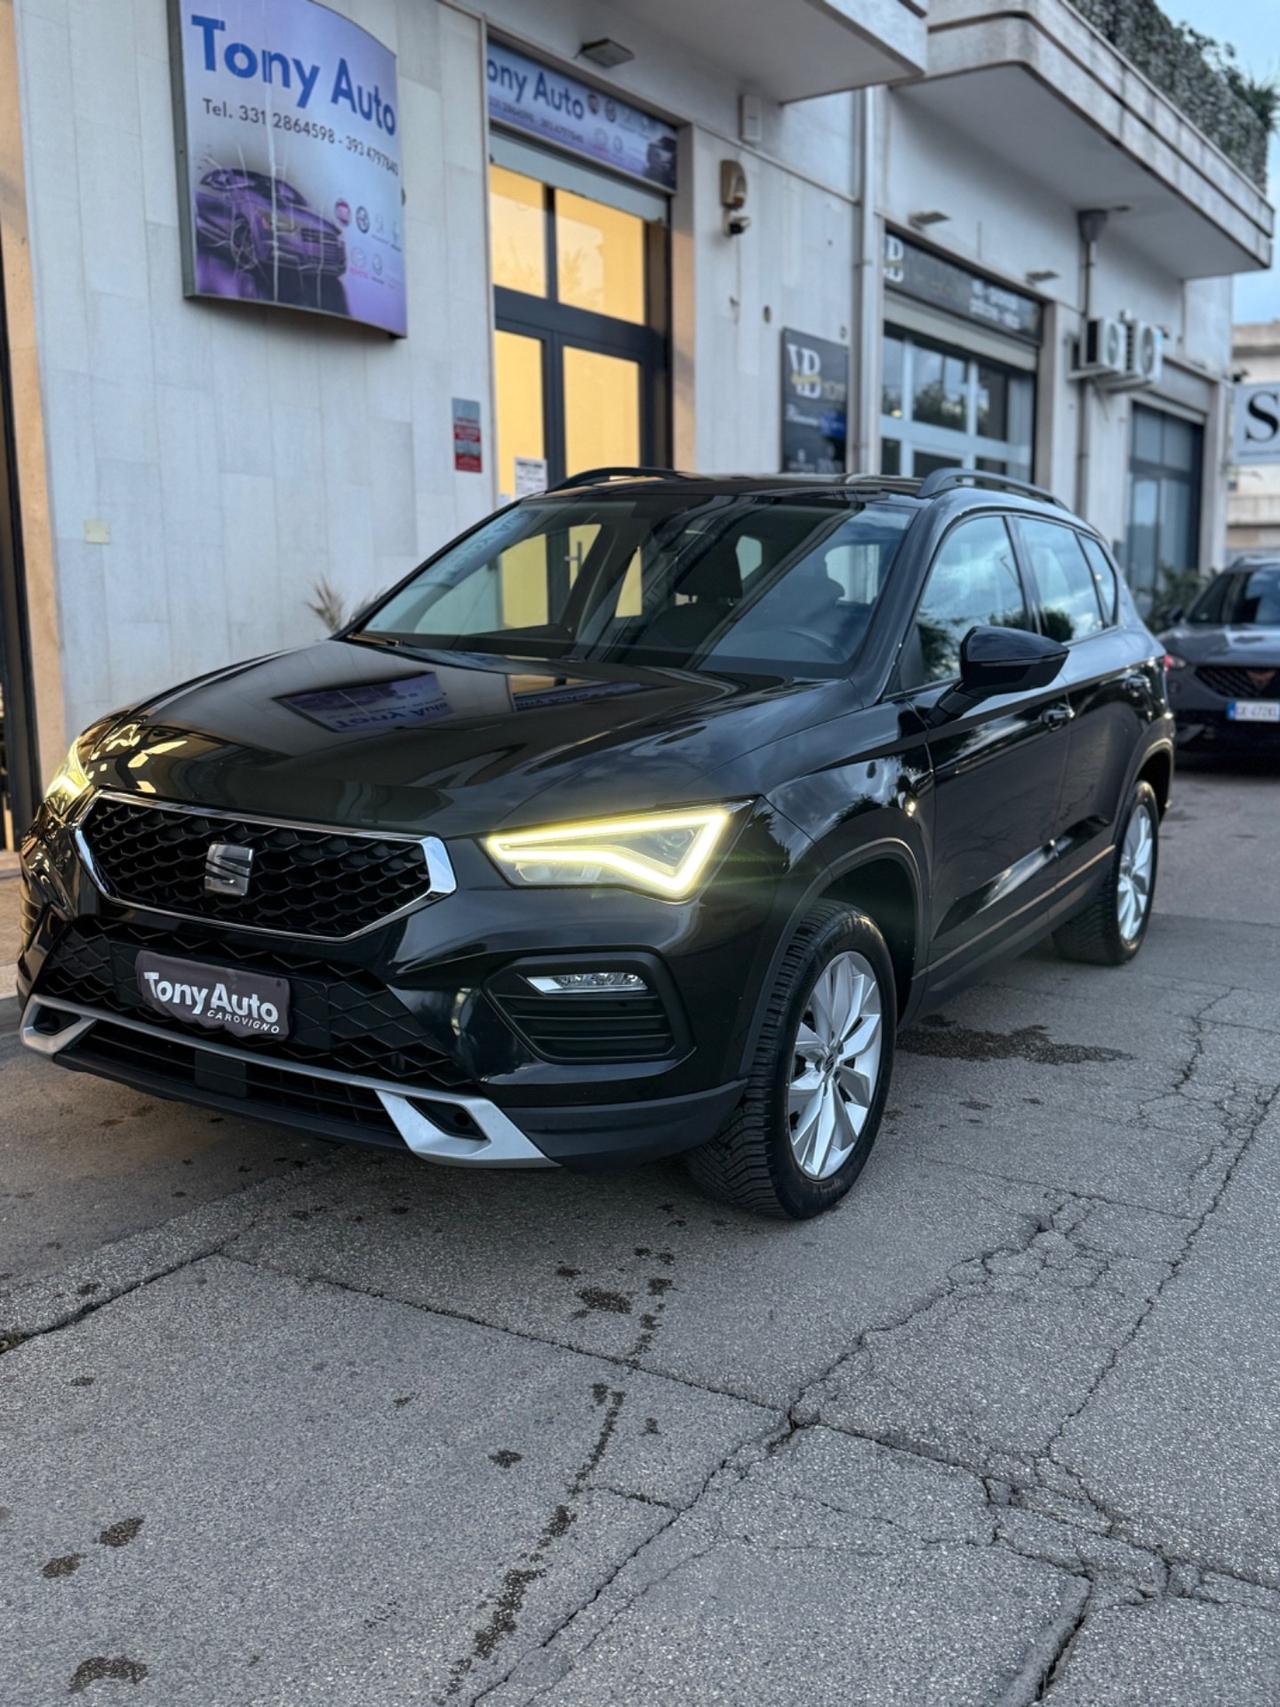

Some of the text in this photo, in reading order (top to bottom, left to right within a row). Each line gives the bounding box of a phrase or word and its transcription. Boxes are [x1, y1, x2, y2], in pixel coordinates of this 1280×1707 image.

[191, 14, 320, 109] Tony
[330, 57, 396, 136] Auto
[487, 58, 528, 102] ony
[533, 71, 585, 120] Auto
[202, 97, 233, 119] Tel.
[239, 104, 266, 125] 331
[272, 112, 335, 144] 2864598
[1245, 390, 1279, 443] S
[207, 1009, 280, 1034] CAROVIGNO
